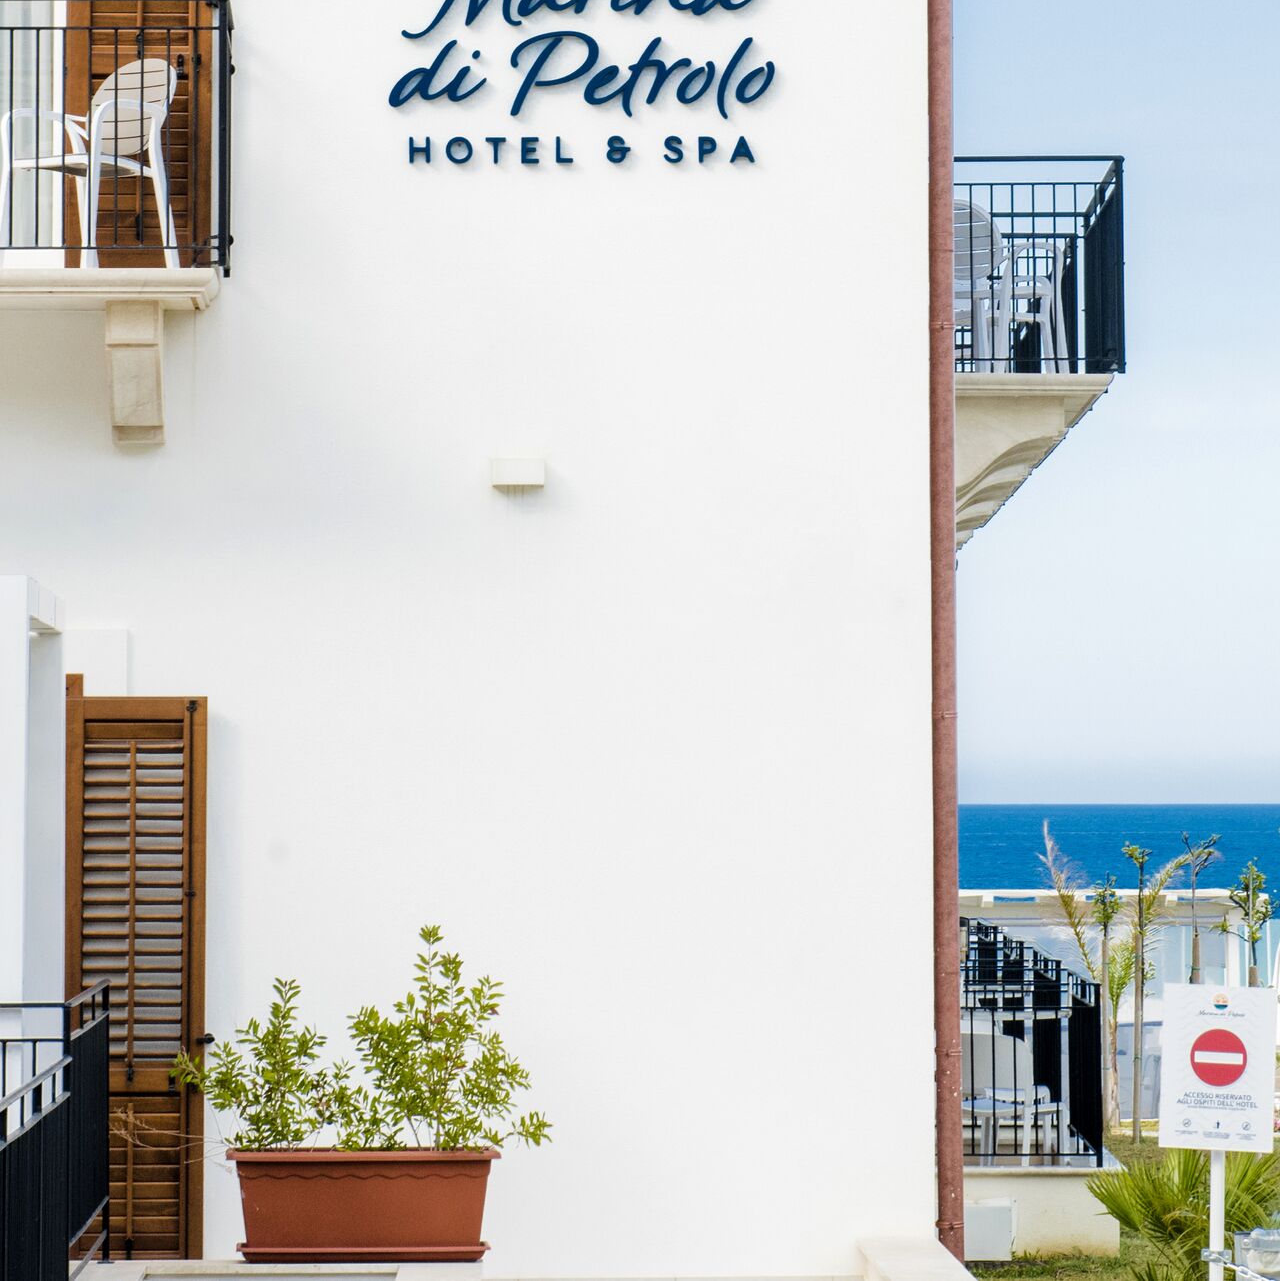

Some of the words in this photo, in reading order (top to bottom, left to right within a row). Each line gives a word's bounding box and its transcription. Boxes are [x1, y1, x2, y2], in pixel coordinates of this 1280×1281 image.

[389, 40, 487, 108] di
[511, 31, 776, 119] Petrolo
[409, 136, 574, 164] HOTEL
[607, 136, 631, 164] &
[664, 136, 756, 164] SPA
[1183, 1091, 1214, 1099] ACCESSO
[1214, 1093, 1252, 1101] RISERVATO
[1193, 1098, 1215, 1106] OSPITI
[1235, 1101, 1258, 1109] HOTEL
